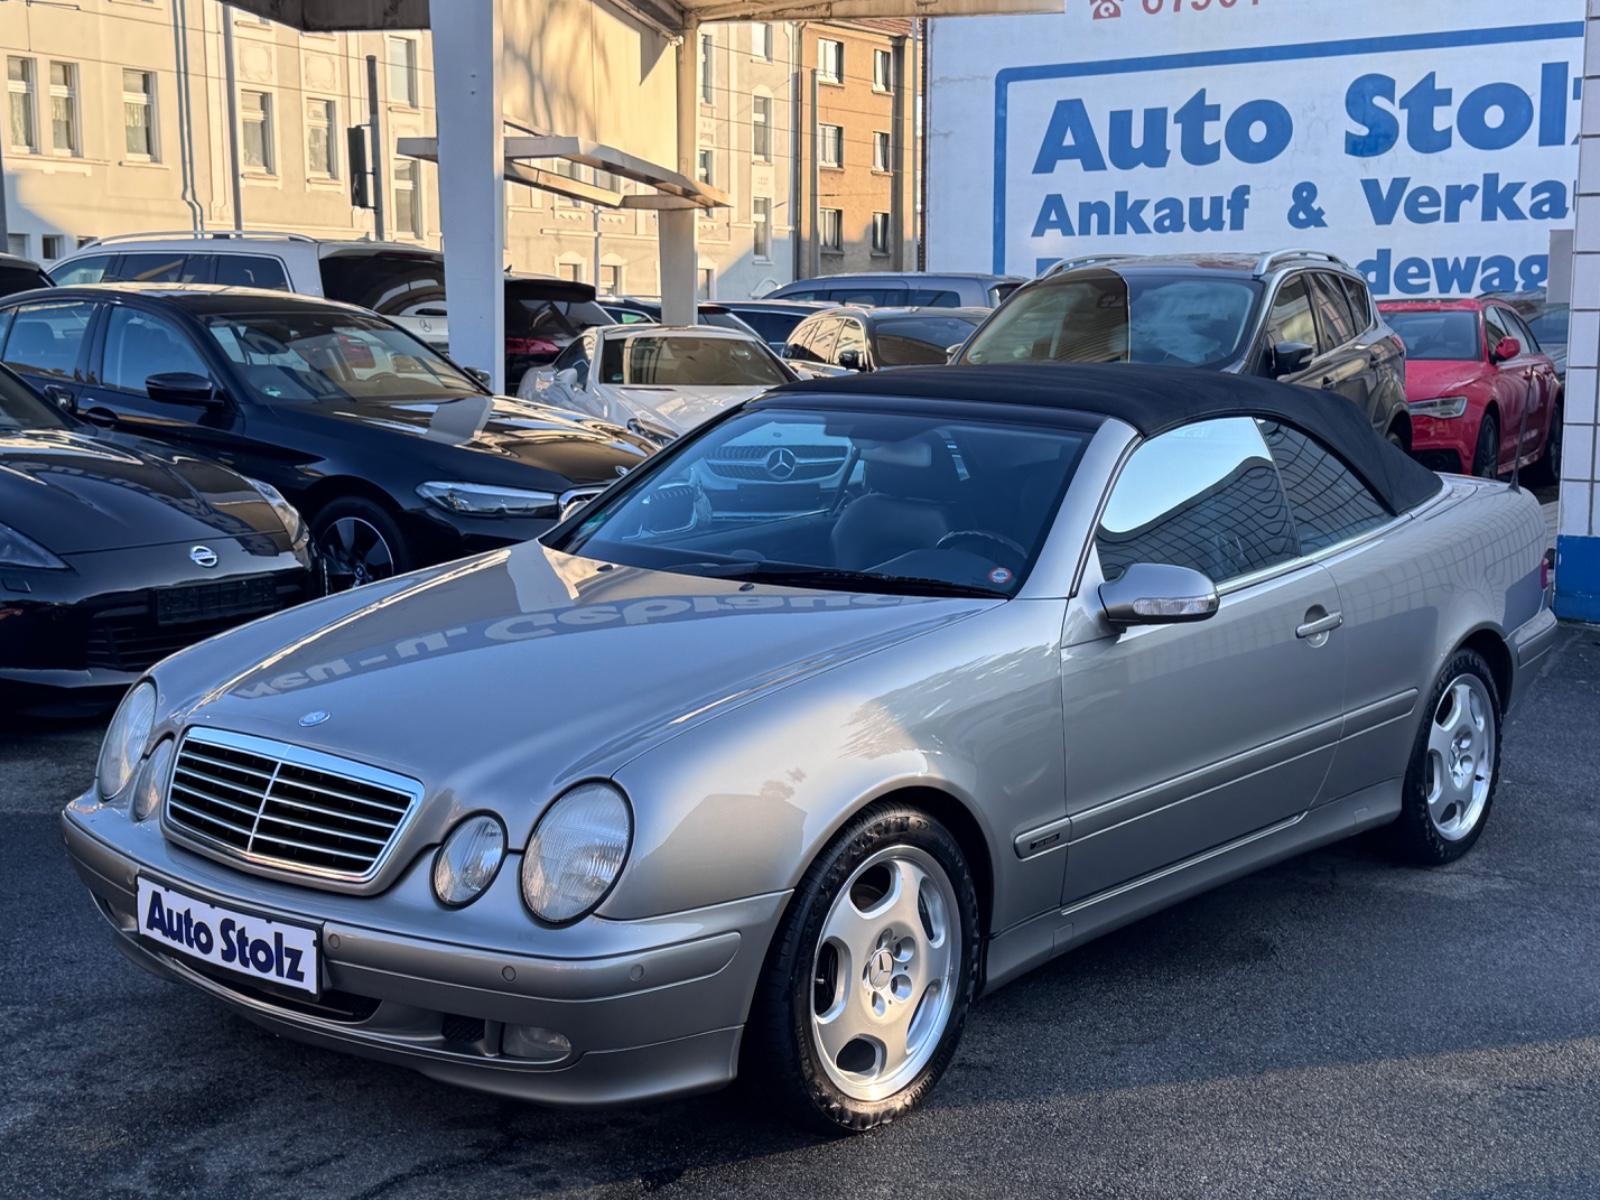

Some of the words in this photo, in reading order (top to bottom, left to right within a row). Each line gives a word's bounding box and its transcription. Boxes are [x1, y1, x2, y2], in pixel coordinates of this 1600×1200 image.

[1031, 89, 1295, 176] Auto
[1344, 61, 1583, 159] Stol
[1031, 184, 1252, 239] Ankauf
[1286, 181, 1328, 229] &
[1360, 171, 1576, 225] Verka
[146, 889, 214, 955] Auto
[220, 918, 305, 983] Stolz
